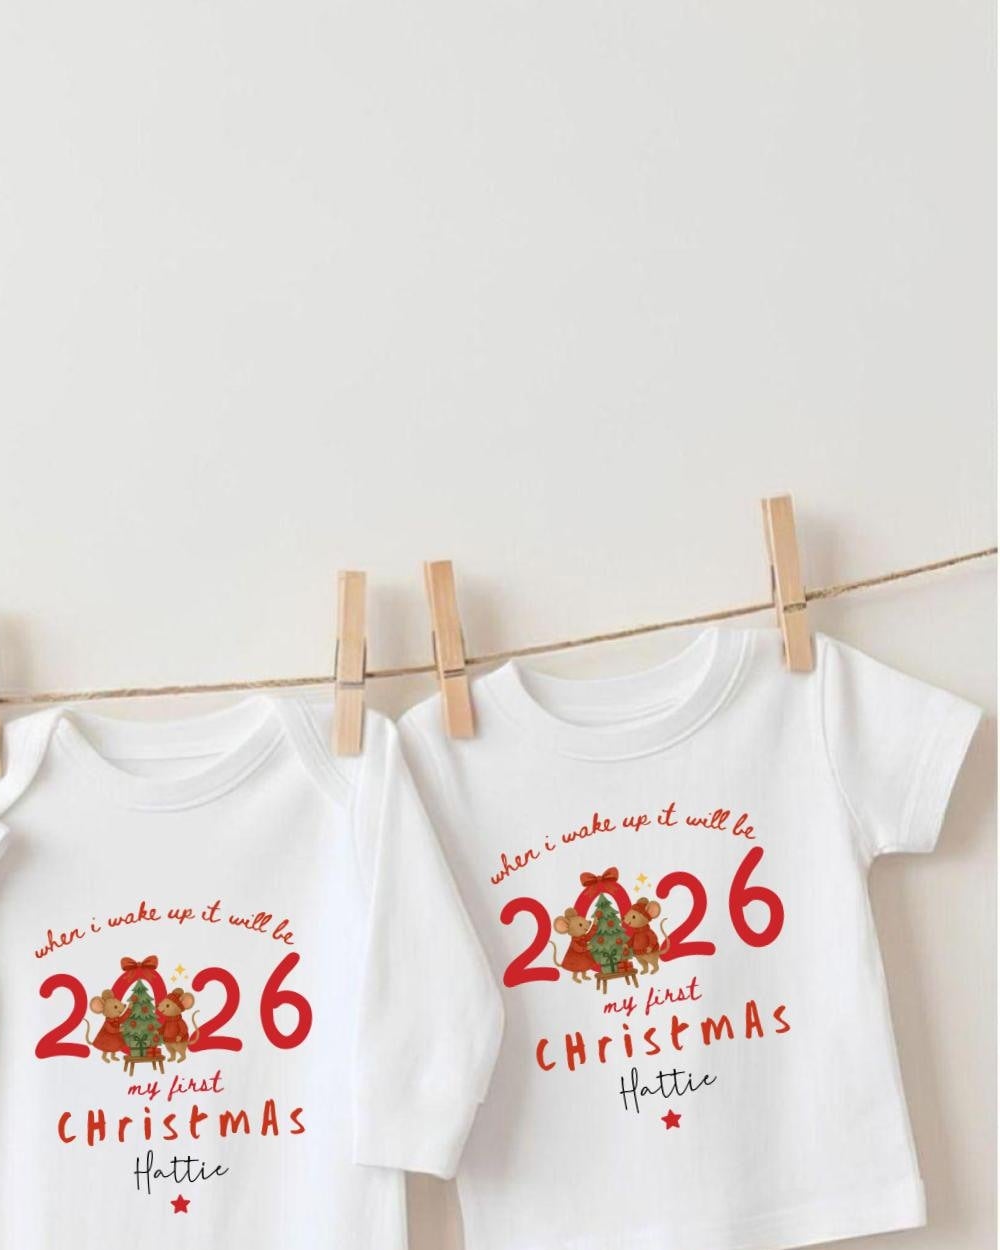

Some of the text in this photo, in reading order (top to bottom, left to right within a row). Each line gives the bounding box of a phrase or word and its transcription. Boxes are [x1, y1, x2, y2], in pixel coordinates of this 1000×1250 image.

[491, 802, 756, 885] when i wake up it will be
[35, 900, 295, 958] when i wake up it will be
[603, 976, 702, 1017] my first
[128, 1070, 224, 1102] my first
[619, 1067, 717, 1114] Hattie
[134, 1150, 229, 1194] Hattie
